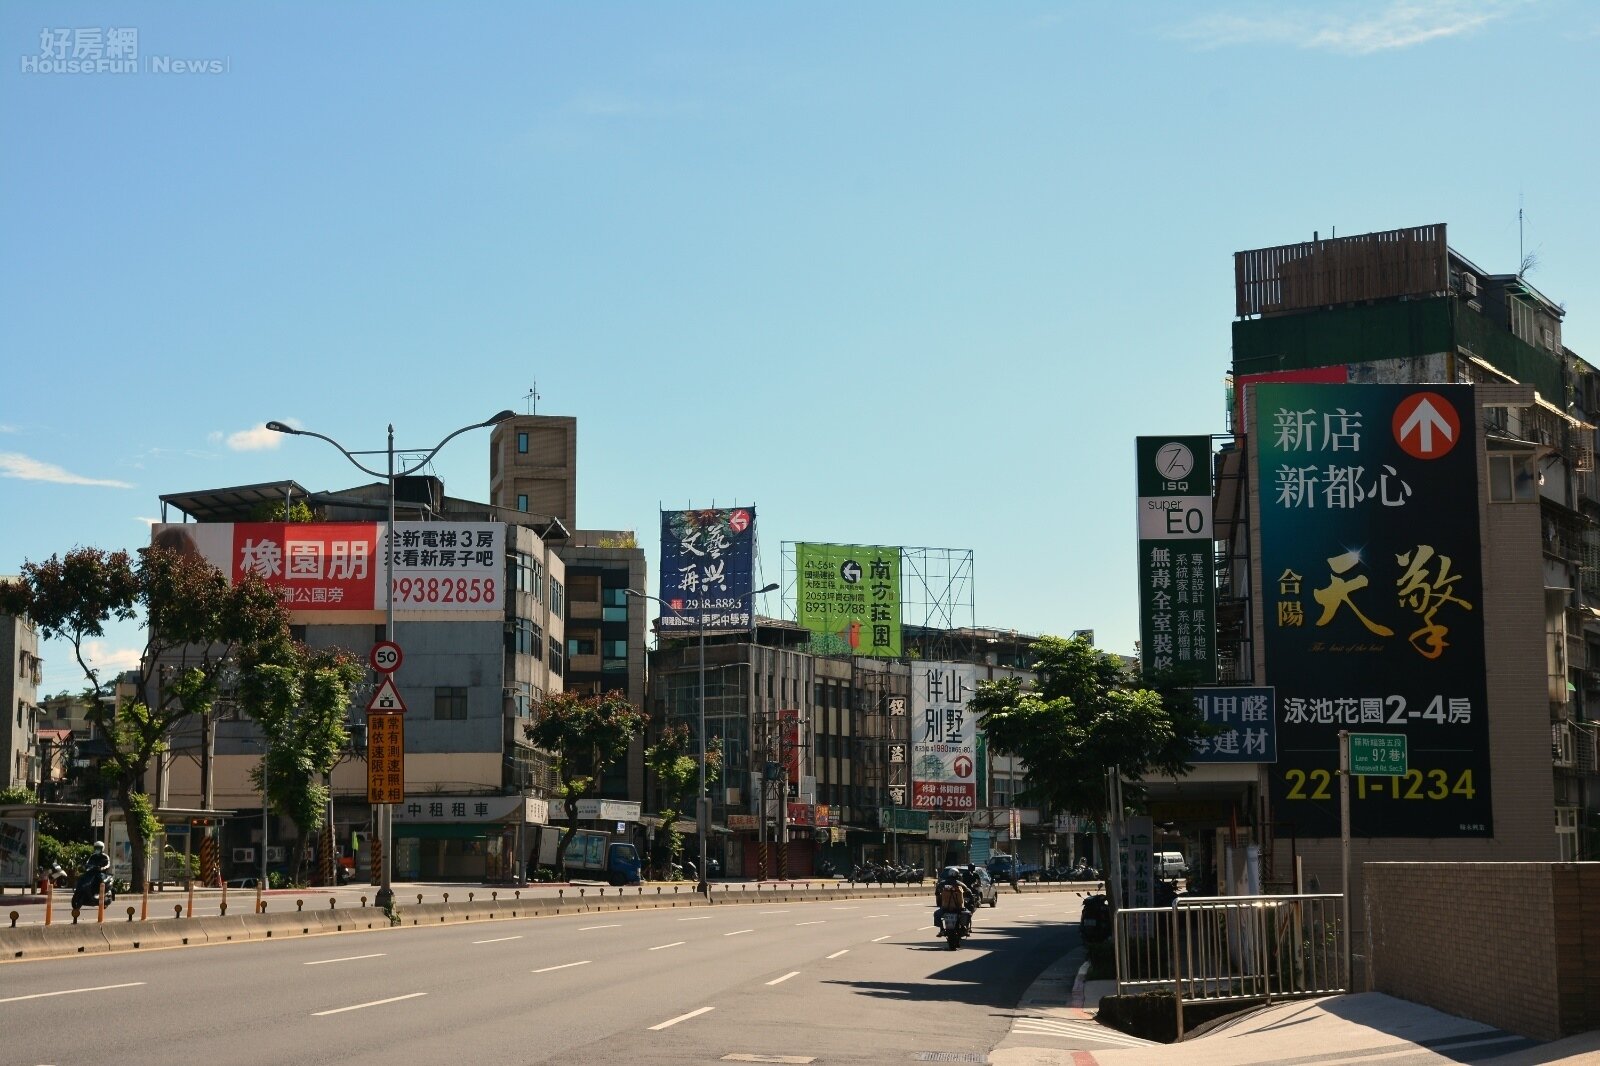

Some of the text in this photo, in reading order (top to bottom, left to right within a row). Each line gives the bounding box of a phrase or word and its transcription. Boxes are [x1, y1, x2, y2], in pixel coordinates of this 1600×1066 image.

[1273, 407, 1363, 452] 新店
[1162, 481, 1189, 491] ISQ
[1275, 463, 1412, 509] 新都心
[1148, 499, 1182, 512] super
[240, 538, 369, 580] 橡園朋
[1175, 552, 1190, 604] 系統家具
[805, 602, 866, 615] 8931-3788
[1190, 552, 1208, 661] 專業設計 原木地板
[1277, 568, 1304, 627] 合陽
[377, 651, 397, 663] 50
[926, 669, 962, 703] 伴山
[925, 709, 963, 743] 別墅
[1283, 695, 1472, 724] 泳池花園2-4房
[371, 718, 385, 801] 請依速限行駛
[387, 718, 400, 801] 常有測速照相
[1354, 738, 1402, 747] 羅斯福路五段
[1285, 769, 1476, 800] 221-1234
[408, 802, 489, 817] 中租租車
